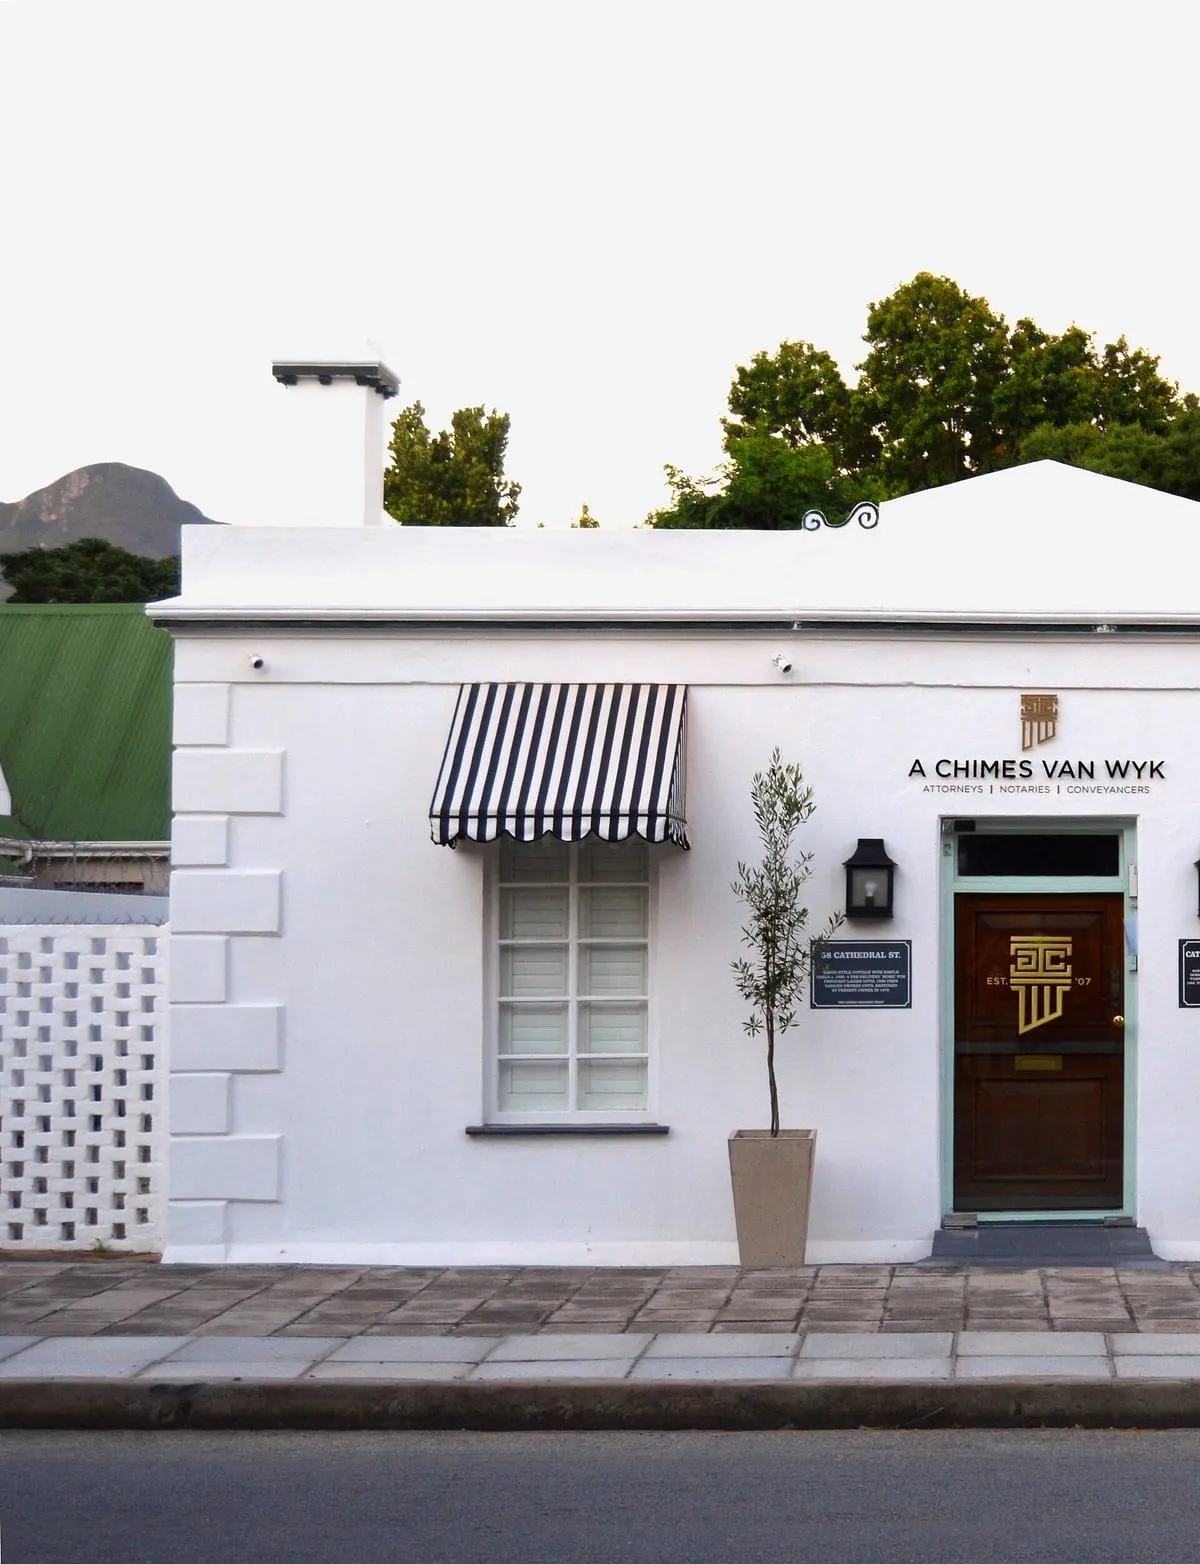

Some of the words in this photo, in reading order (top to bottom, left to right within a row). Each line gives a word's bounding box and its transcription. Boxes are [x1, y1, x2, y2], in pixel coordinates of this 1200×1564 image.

[908, 759, 926, 777] A
[935, 759, 1033, 779] CHIMES
[1042, 760, 1095, 779] VAN
[1104, 760, 1166, 779] WYK
[923, 785, 984, 794] ATTORNEYS
[1000, 785, 1051, 794] NOTARIES
[1067, 785, 1150, 794] CONVEYANCERS
[833, 951, 886, 959] CATHEDRAL
[888, 951, 901, 959] ST.
[987, 977, 1009, 985] EST.
[1075, 977, 1091, 986] '07
